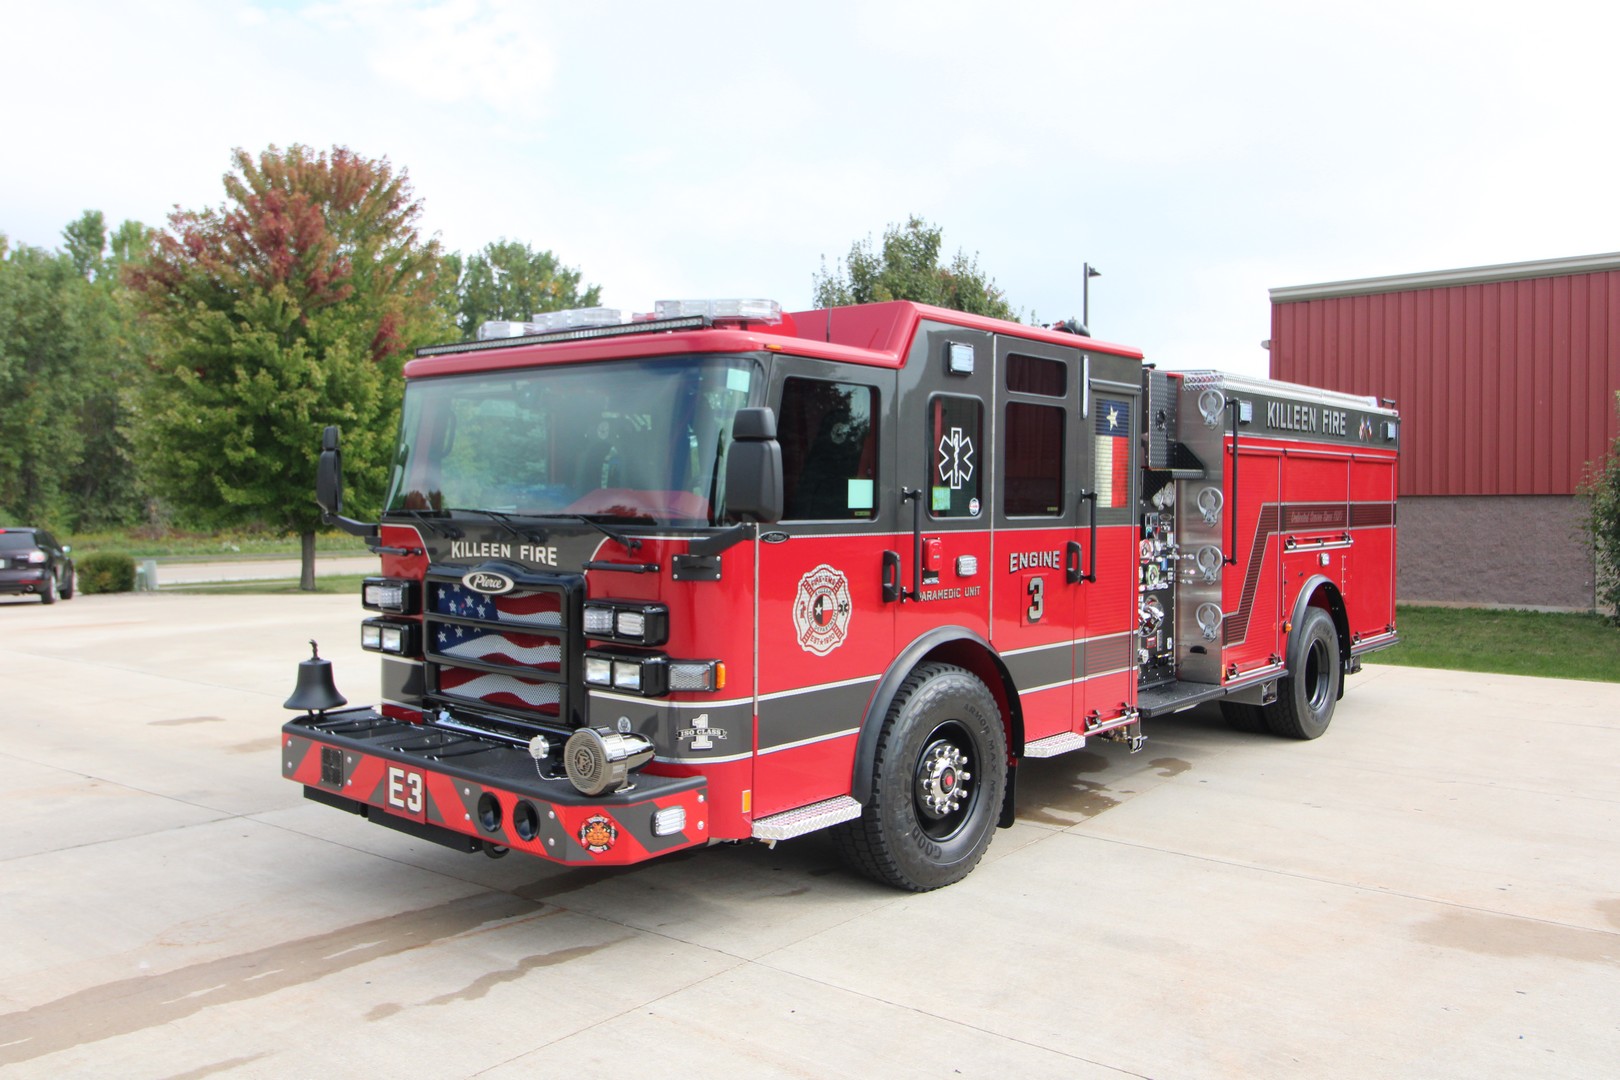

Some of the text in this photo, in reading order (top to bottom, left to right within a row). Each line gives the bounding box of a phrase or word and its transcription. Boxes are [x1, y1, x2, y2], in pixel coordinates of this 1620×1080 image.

[1267, 401, 1347, 436] KILLEEN FIRE
[451, 541, 558, 567] KILLEEN FIRE
[1009, 551, 1060, 574] ENGINE
[473, 573, 502, 589] Pierce
[964, 586, 981, 597] UNIT
[1027, 576, 1044, 624] 3
[691, 713, 712, 749] 1
[963, 703, 990, 735] ARMOR
[987, 740, 997, 772] MAX
[388, 766, 422, 812] E3
